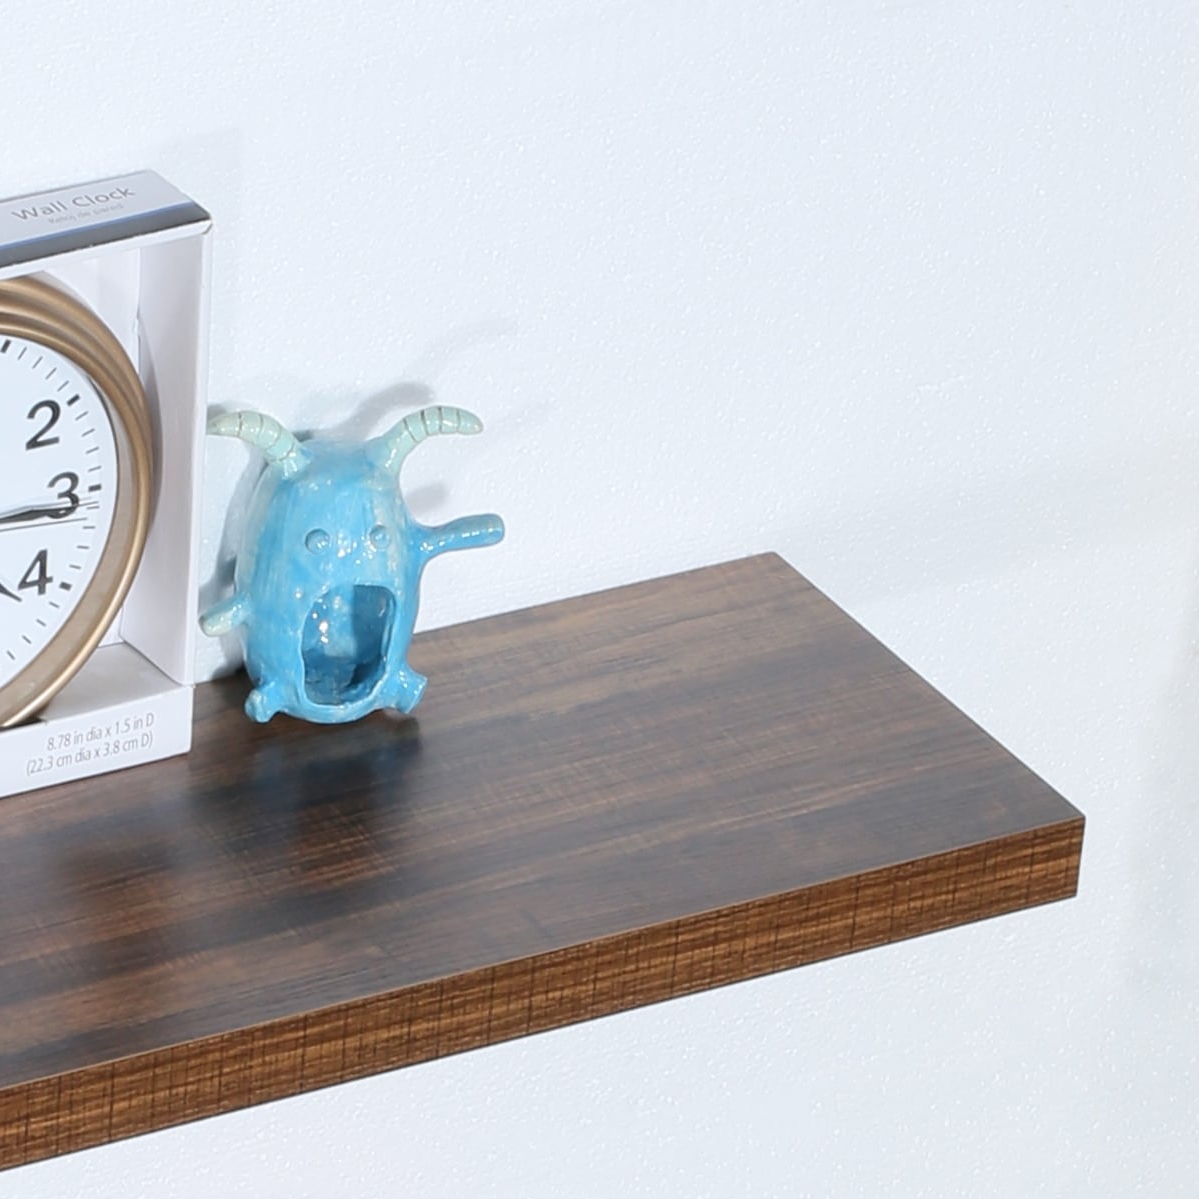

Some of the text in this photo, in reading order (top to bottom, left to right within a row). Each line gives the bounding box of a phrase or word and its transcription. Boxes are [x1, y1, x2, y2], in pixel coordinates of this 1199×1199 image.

[10, 187, 136, 220] Wall Clock
[25, 400, 62, 451] 2
[46, 471, 80, 519] 3
[17, 549, 54, 596] 4
[25, 730, 154, 777] (22.3 cm dia x 3.8 cm D)
[46, 712, 155, 751] 8.78 in dia x 1.5 in D
